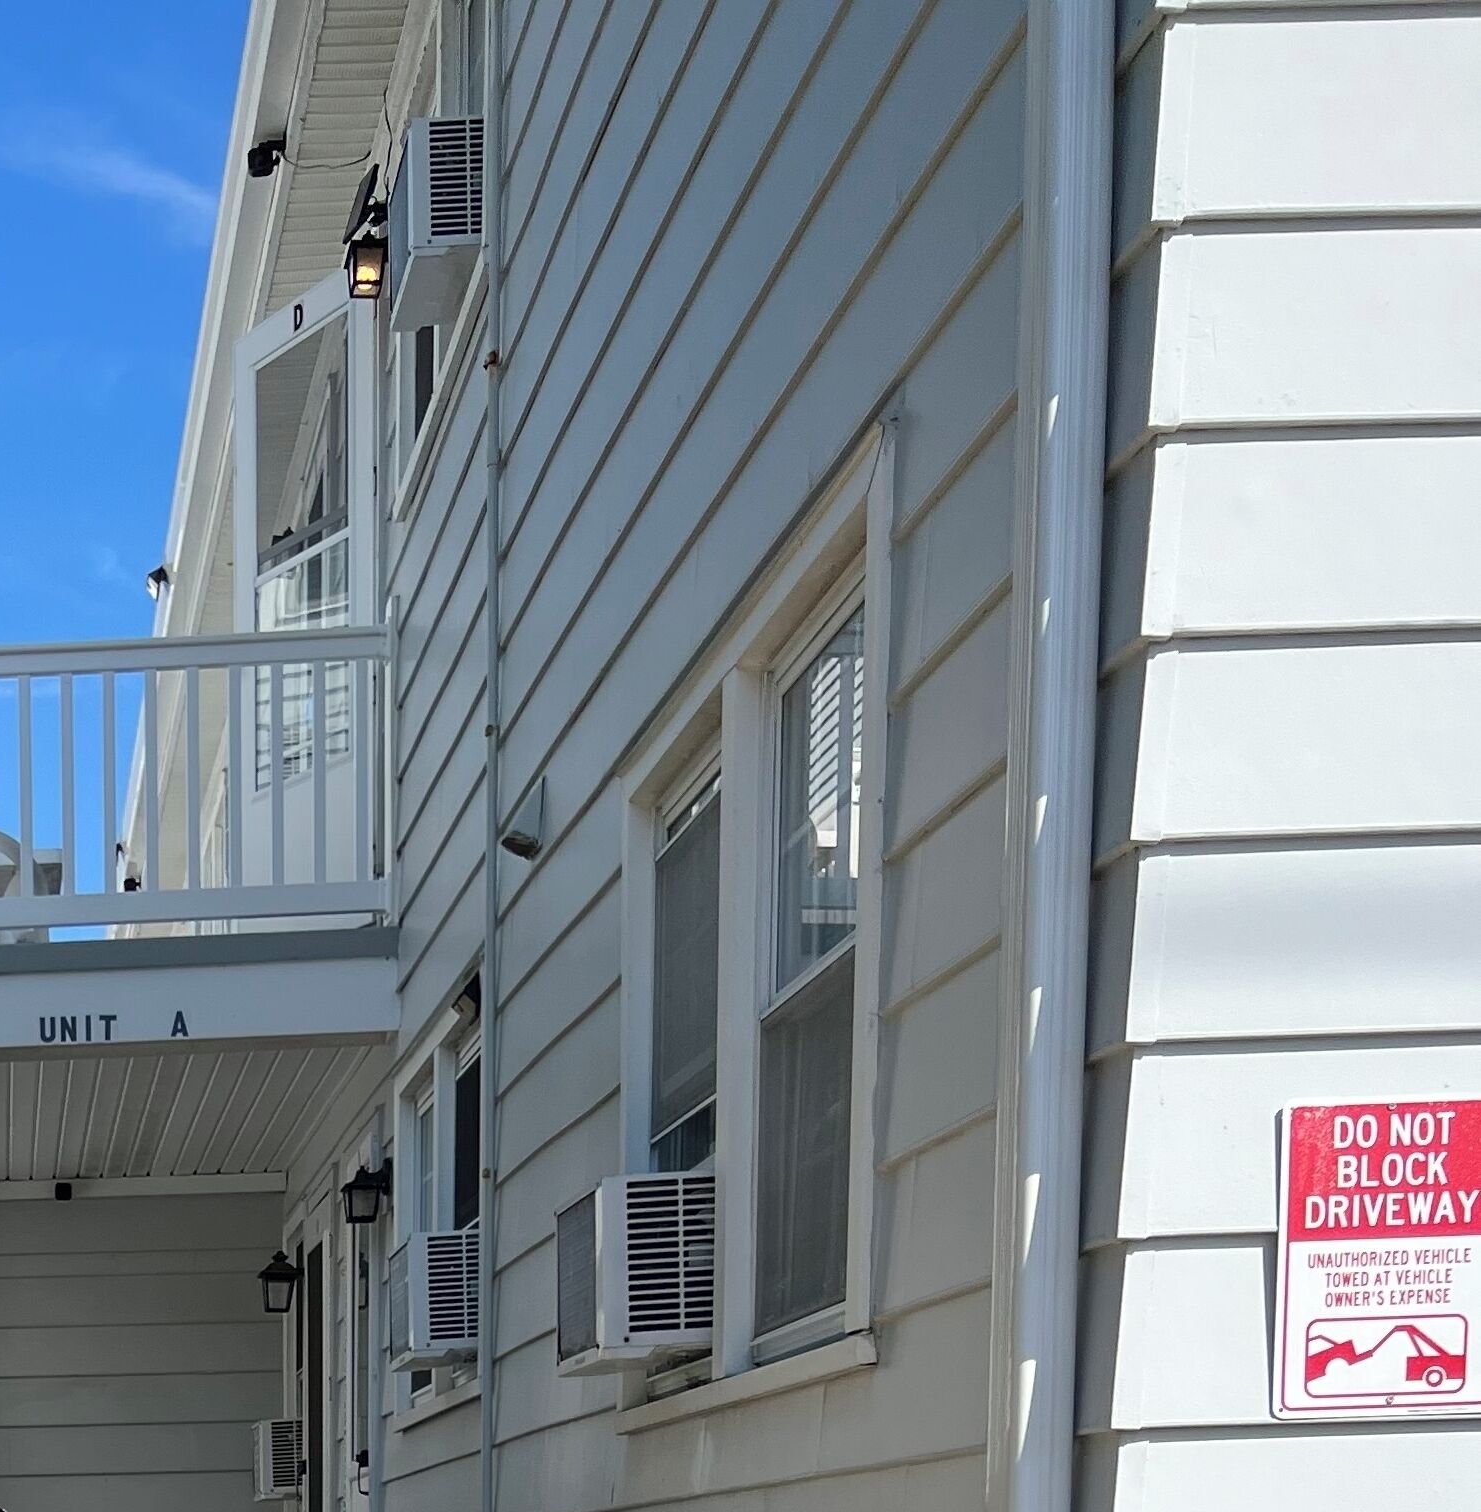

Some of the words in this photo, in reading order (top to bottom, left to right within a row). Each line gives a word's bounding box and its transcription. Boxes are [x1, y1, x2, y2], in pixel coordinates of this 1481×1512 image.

[293, 303, 305, 332] D
[39, 1014, 118, 1043] UNIT
[170, 1010, 190, 1038] A
[1332, 1114, 1379, 1149] DO
[1389, 1111, 1456, 1147] NOT
[1336, 1151, 1449, 1189] BLOCK
[1304, 1189, 1481, 1230] DRIVEWAY
[1307, 1250, 1410, 1269] UNAUTHORIZED
[1415, 1247, 1473, 1265] VEHICLE
[1325, 1271, 1369, 1288] TOWED
[1374, 1270, 1391, 1286] AT
[1396, 1268, 1453, 1286] VEHICLE
[1324, 1290, 1385, 1308] OWNER'S
[1390, 1288, 1451, 1306] EXPENSE
